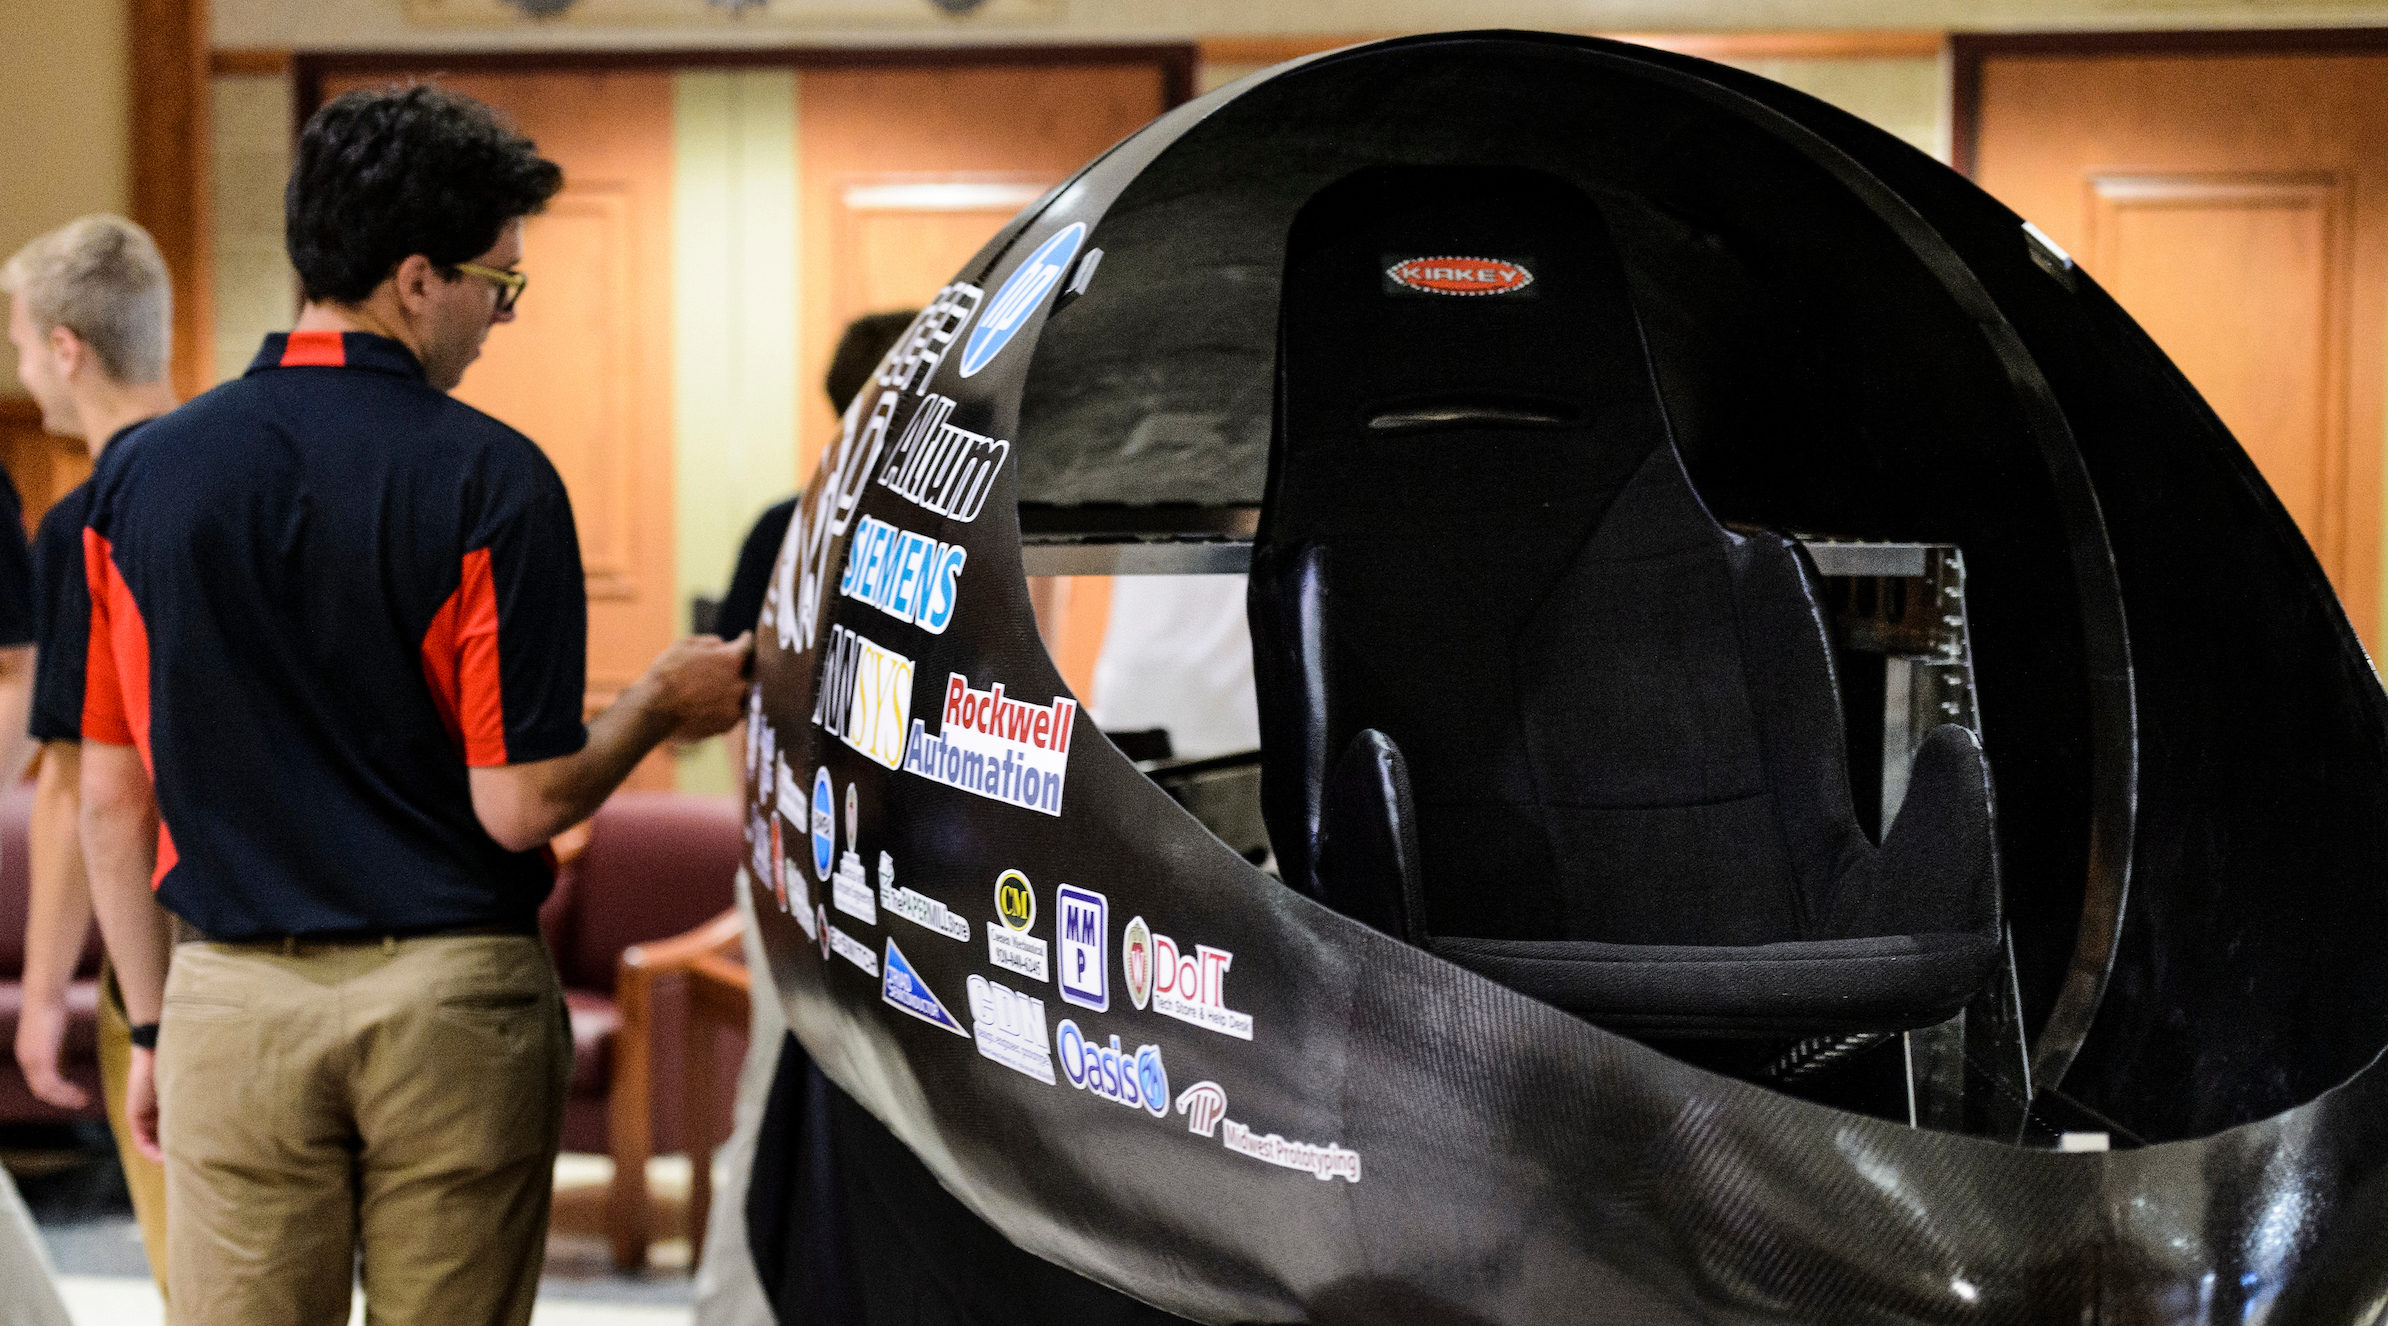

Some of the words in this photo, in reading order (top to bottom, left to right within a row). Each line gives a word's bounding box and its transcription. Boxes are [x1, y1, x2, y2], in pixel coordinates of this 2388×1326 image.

[1402, 266, 1517, 283] KIRKEY
[877, 393, 1010, 523] Altium
[842, 518, 966, 629] SIEMENS
[813, 625, 914, 769] ANSYS
[945, 677, 1073, 753] Rockwell
[905, 723, 1061, 814] Automation
[1000, 886, 1030, 920] CM
[1066, 905, 1096, 946] MM
[1156, 940, 1227, 1007] DoIT
[1174, 1000, 1197, 1018] Store
[1060, 1025, 1139, 1105] Oasis
